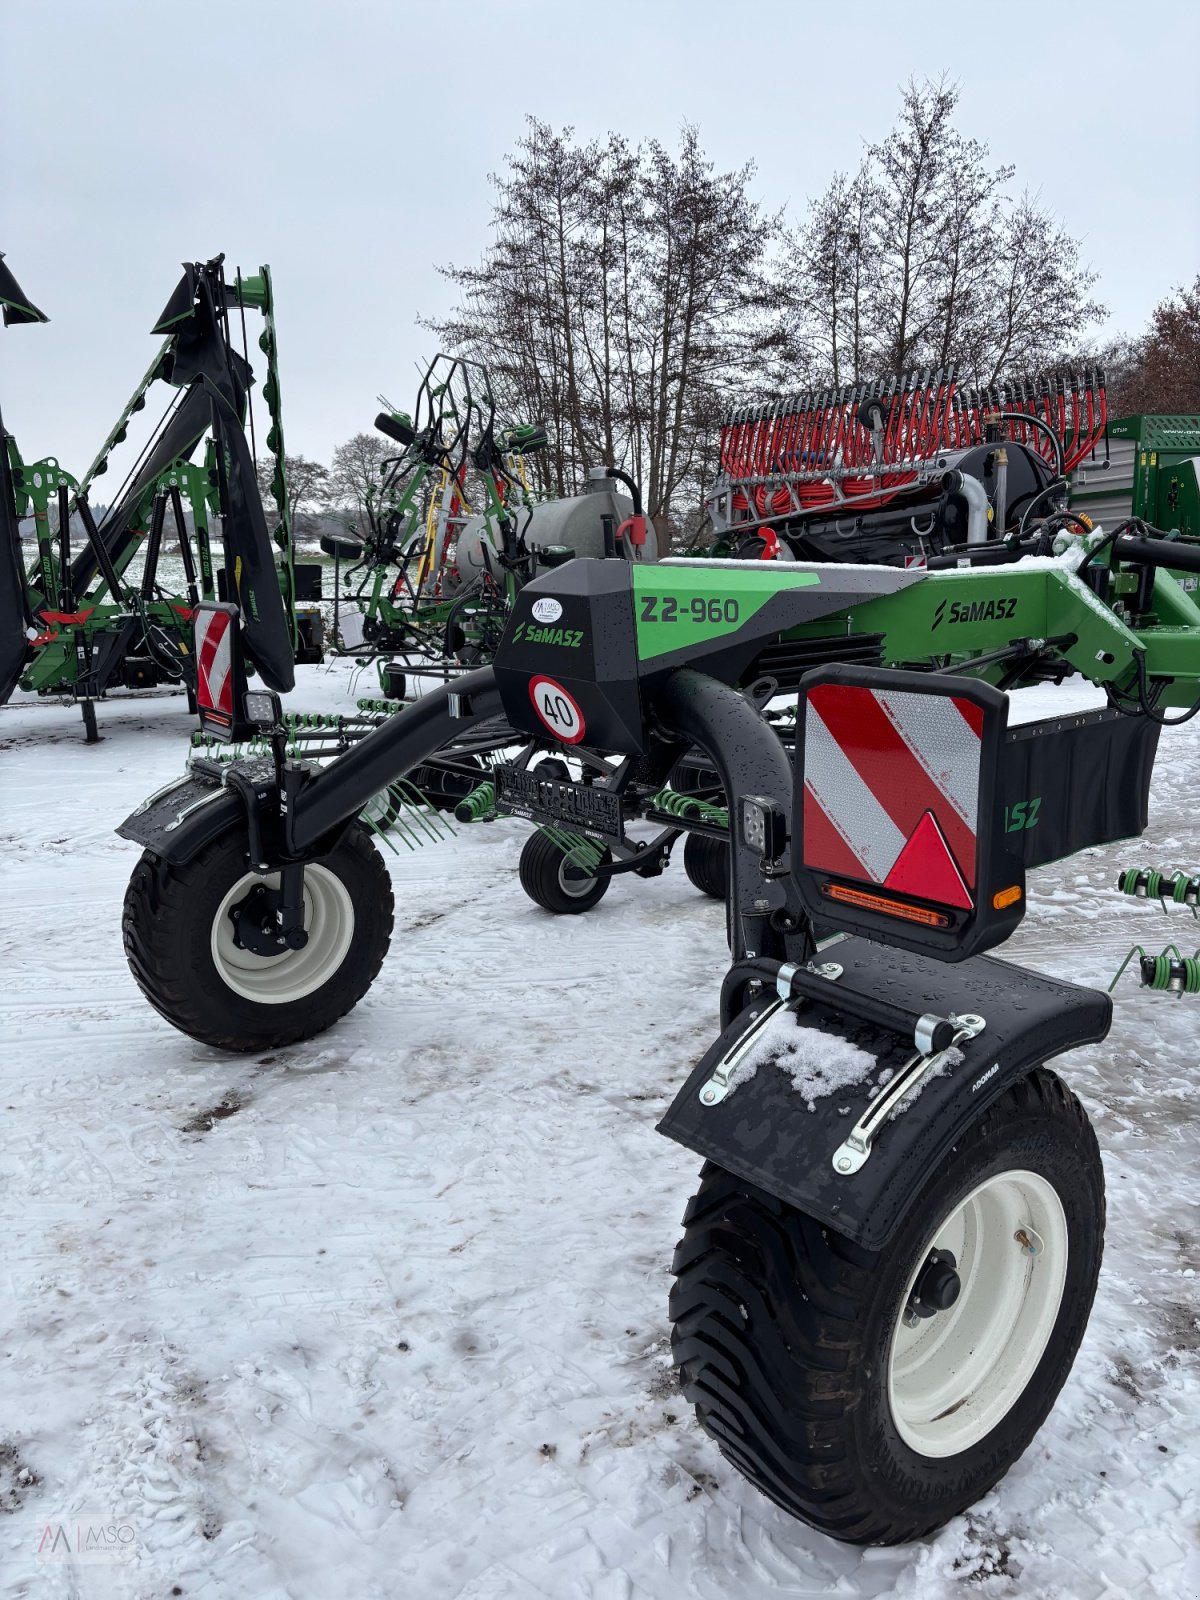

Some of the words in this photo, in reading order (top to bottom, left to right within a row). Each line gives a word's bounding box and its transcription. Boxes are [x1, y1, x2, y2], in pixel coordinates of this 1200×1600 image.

[640, 596, 739, 623] Z2-960
[948, 597, 1018, 624] SaMASZ
[525, 625, 584, 648] SaMASZ
[543, 693, 573, 727] 40
